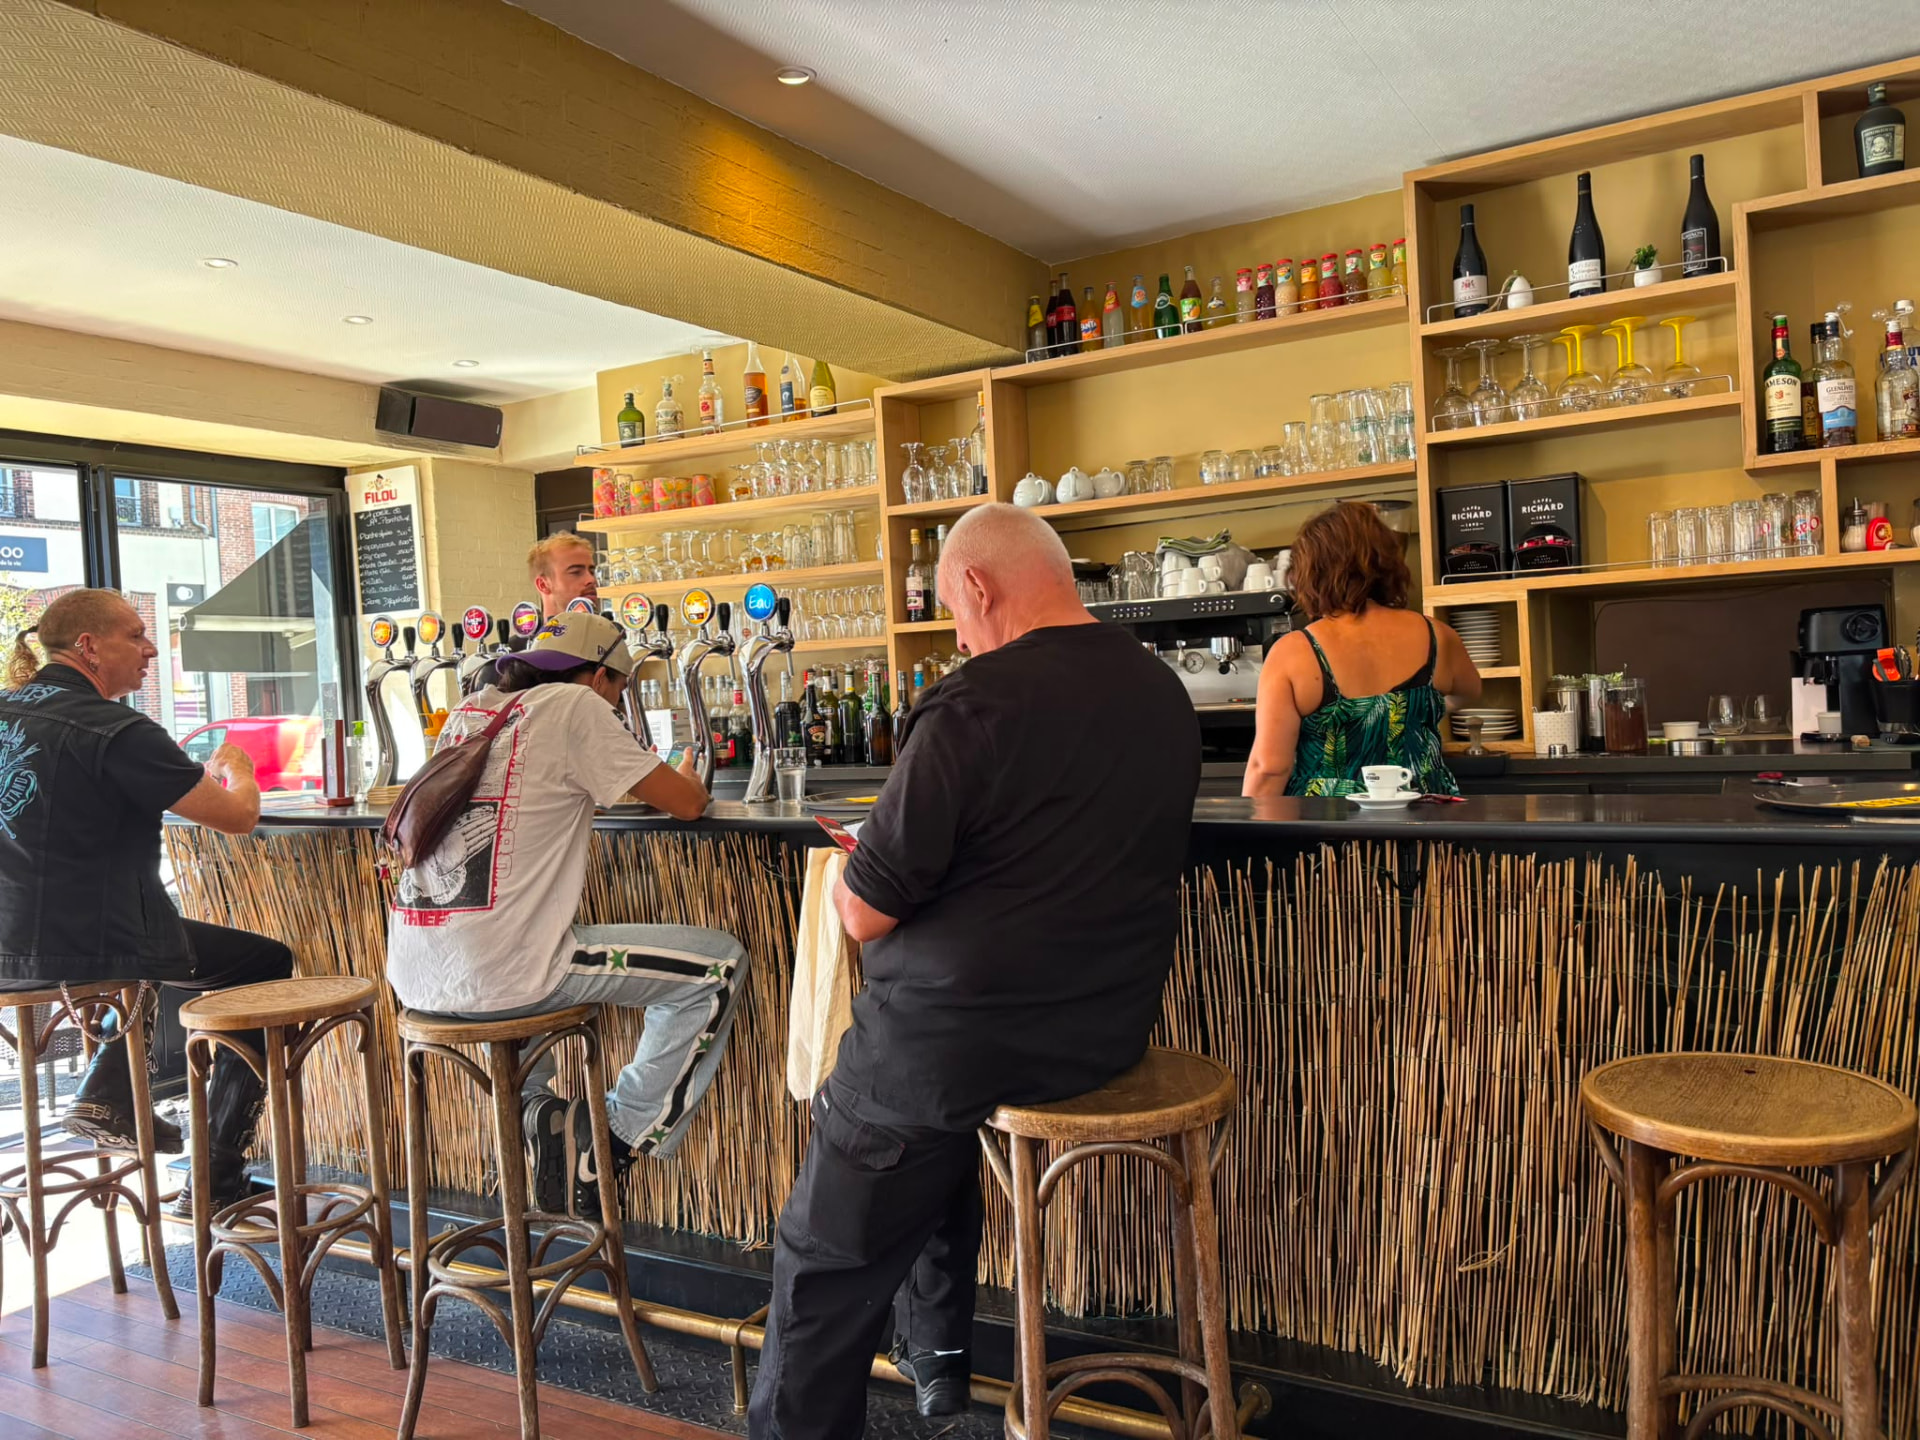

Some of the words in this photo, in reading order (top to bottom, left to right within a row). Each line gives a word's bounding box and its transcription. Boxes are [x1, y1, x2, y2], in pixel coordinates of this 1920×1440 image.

[1766, 377, 1798, 388] AMESON
[365, 488, 398, 504] FILOU
[1521, 503, 1564, 514] RICHARD
[1451, 510, 1493, 521] RICHARD
[0, 546, 24, 559] OO
[749, 595, 771, 609] Eau
[1, 776, 28, 808] STAND
